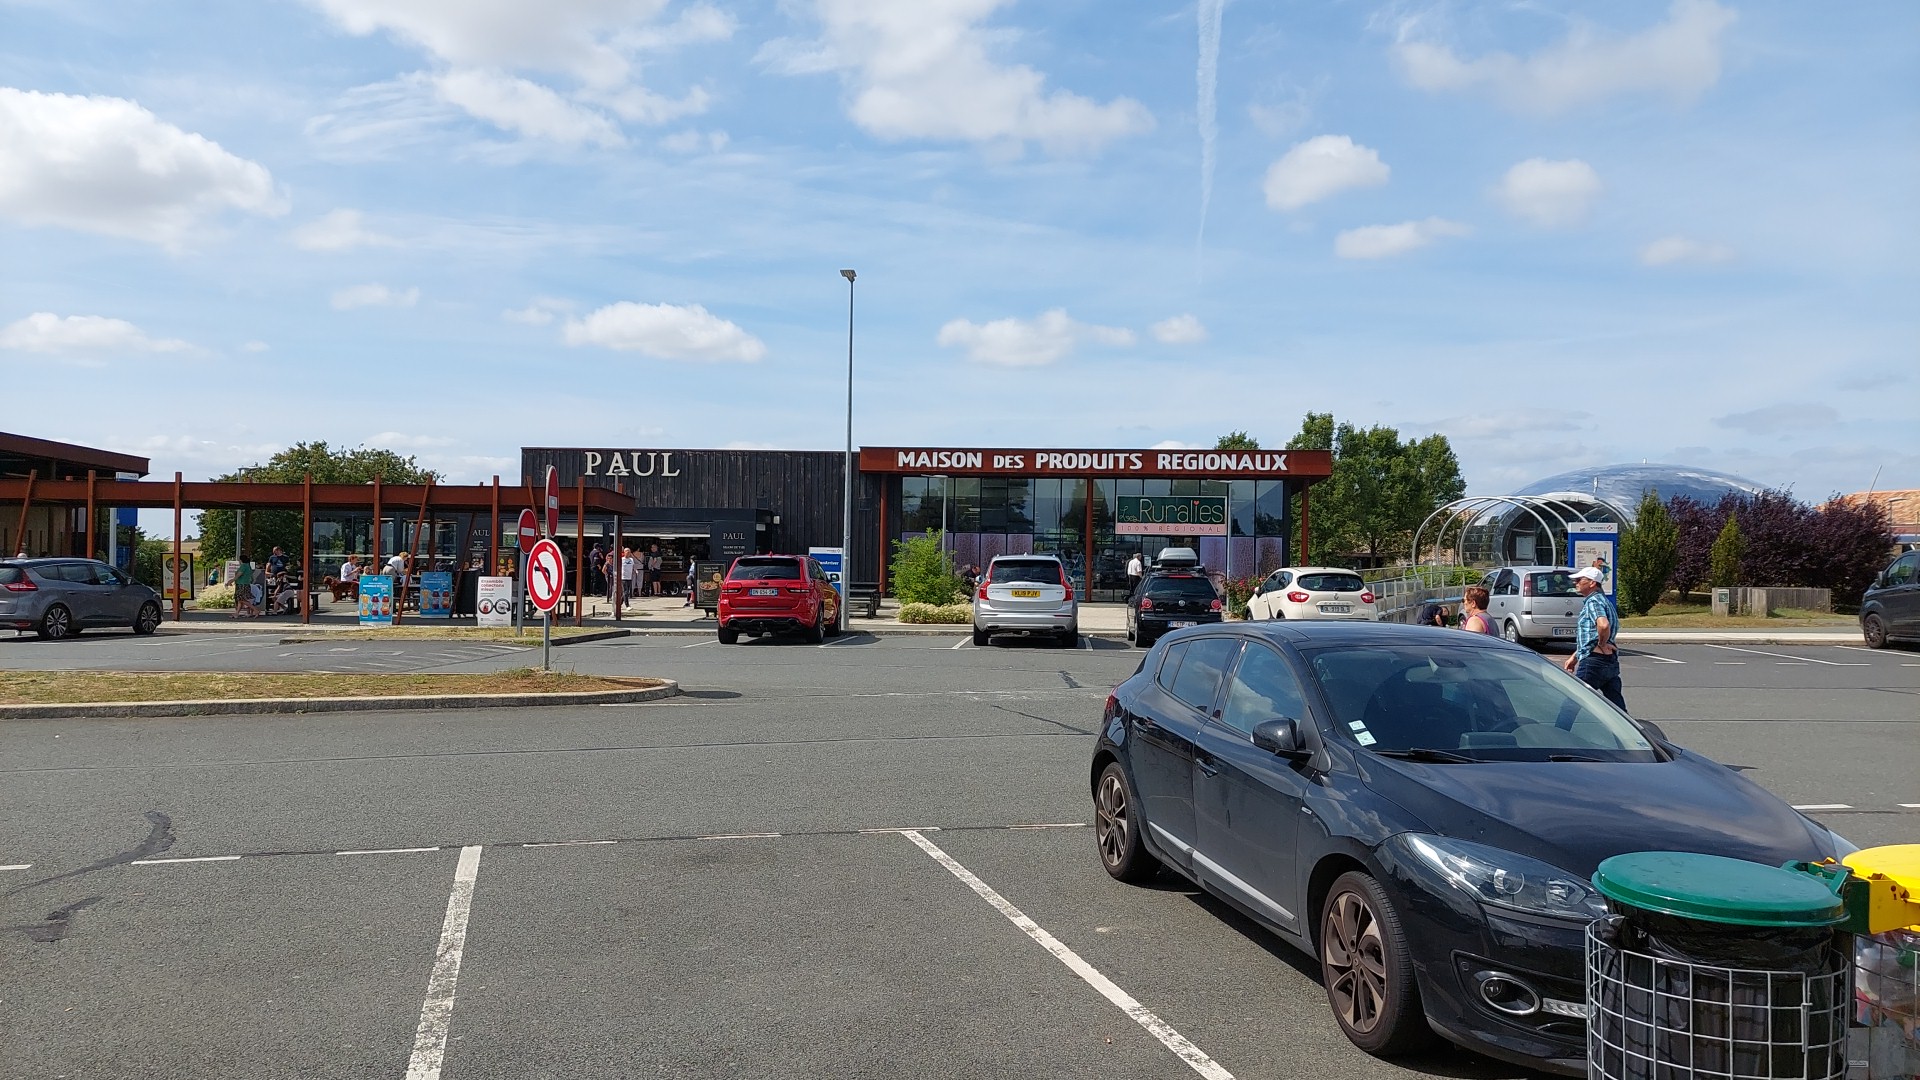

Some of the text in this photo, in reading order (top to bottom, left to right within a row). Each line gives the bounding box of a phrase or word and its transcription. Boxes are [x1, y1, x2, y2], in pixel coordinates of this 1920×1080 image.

[584, 451, 680, 477] PAUL
[897, 451, 1288, 471] MAISON DES PRODUITS REGIONAUX
[1139, 498, 1223, 523] Ruralies
[722, 532, 746, 540] PAUL
